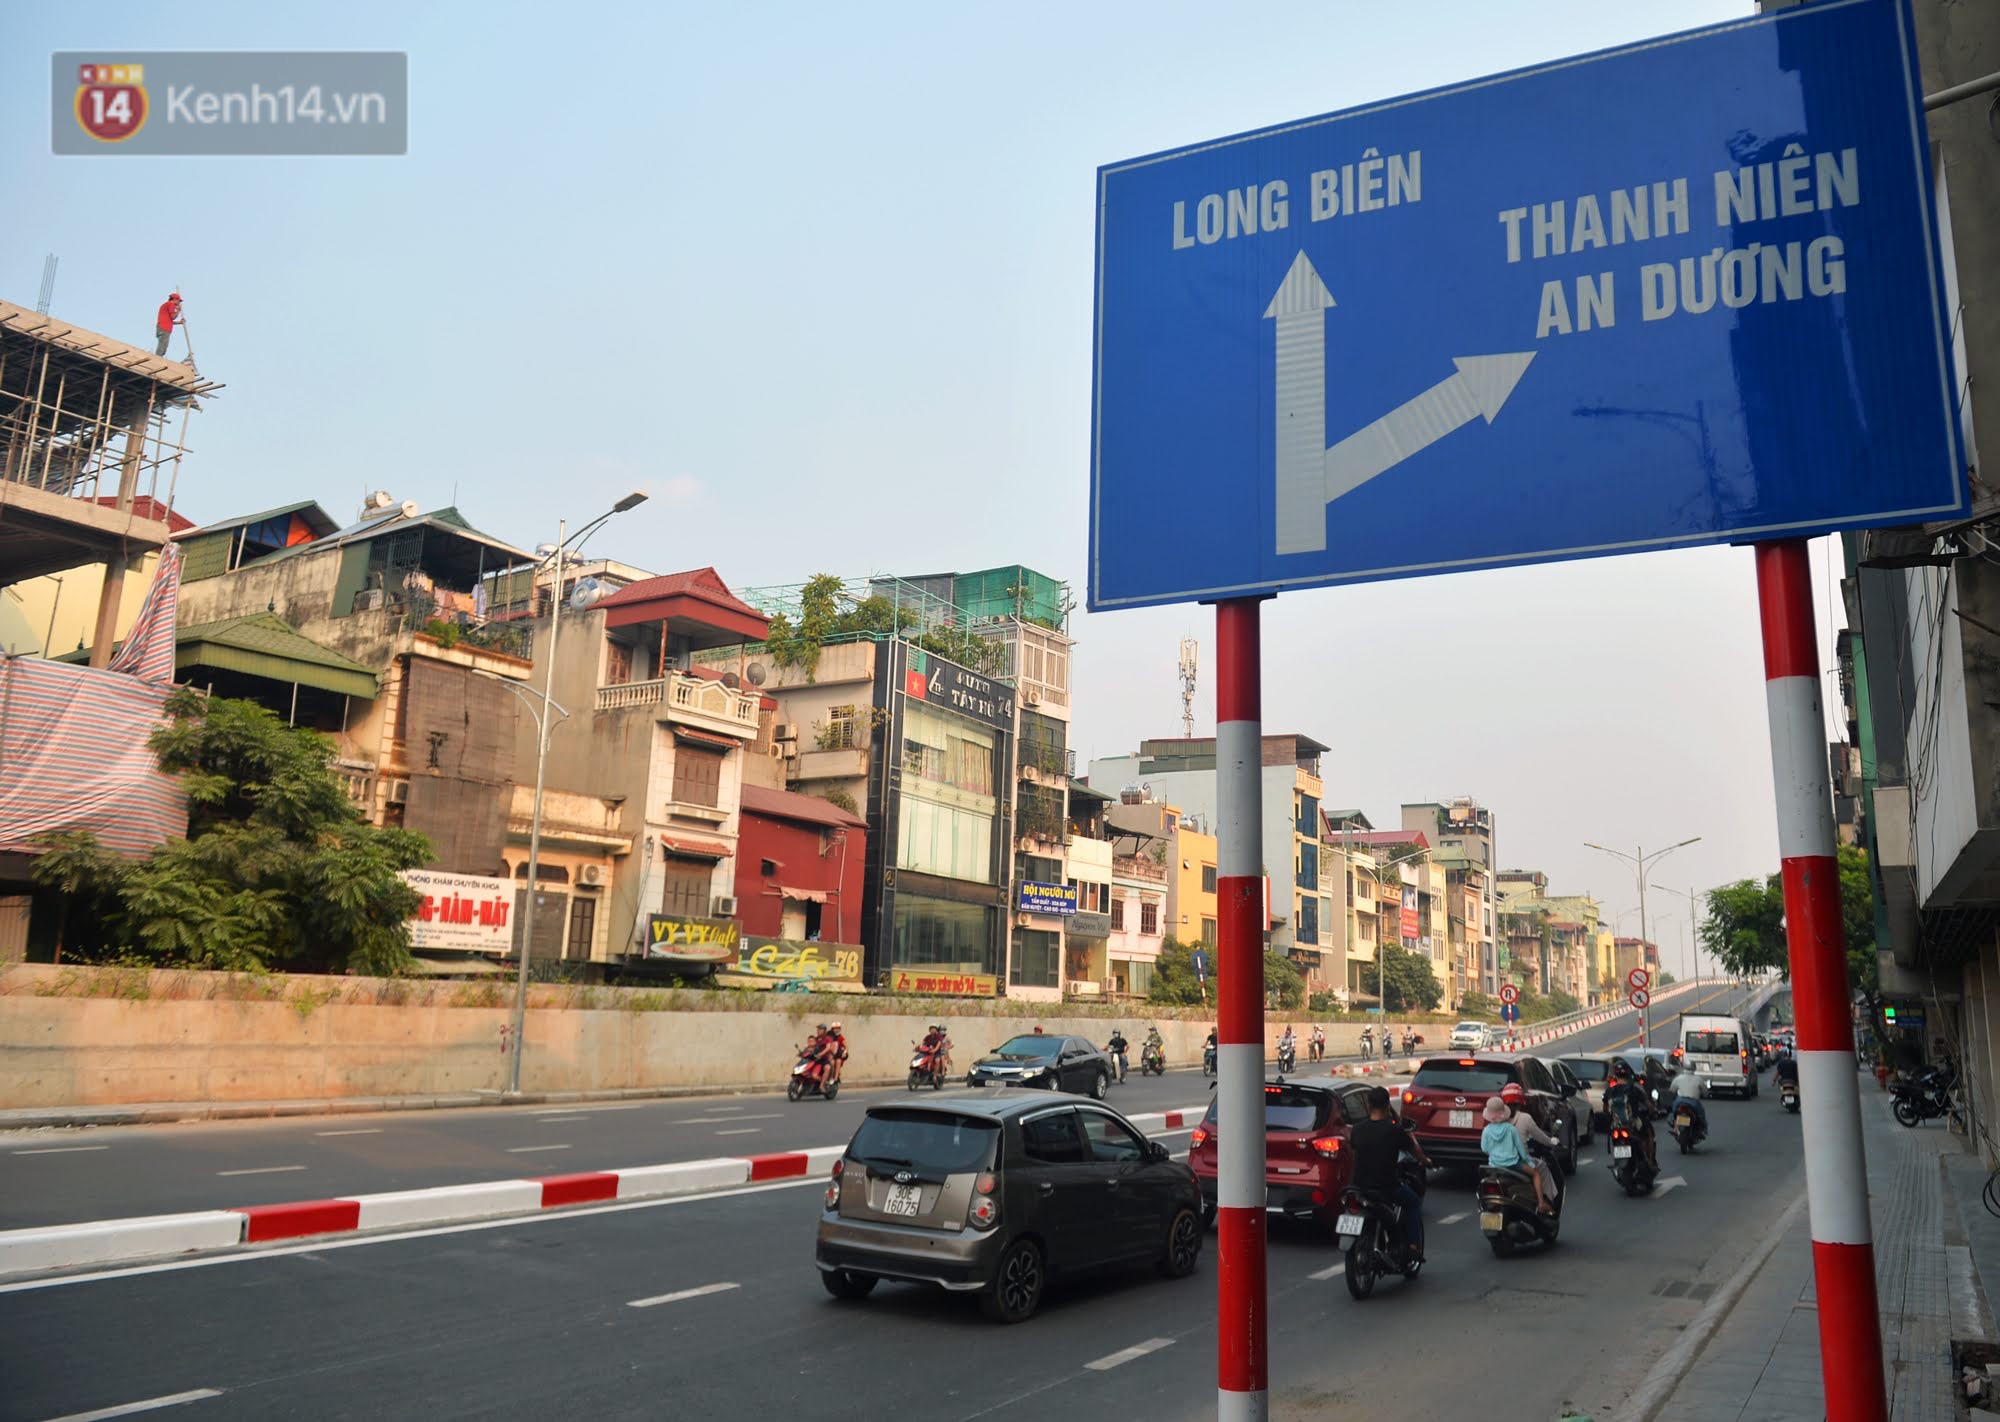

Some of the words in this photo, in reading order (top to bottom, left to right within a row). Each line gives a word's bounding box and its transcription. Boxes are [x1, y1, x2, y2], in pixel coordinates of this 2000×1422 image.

[1173, 179, 1289, 250] LONG
[1311, 147, 1421, 223] BIÊN
[1498, 177, 1689, 263] THANH
[1714, 143, 1860, 227] NIÊN
[1536, 271, 1616, 338] AN
[1640, 235, 1847, 321] DƯƠNG
[998, 696, 1012, 718] 74
[1023, 883, 1038, 897] HỘI
[1039, 885, 1064, 899] NGƯỜI
[652, 920, 680, 944] VY
[683, 923, 711, 944] VY
[895, 1186, 915, 1200] 30E
